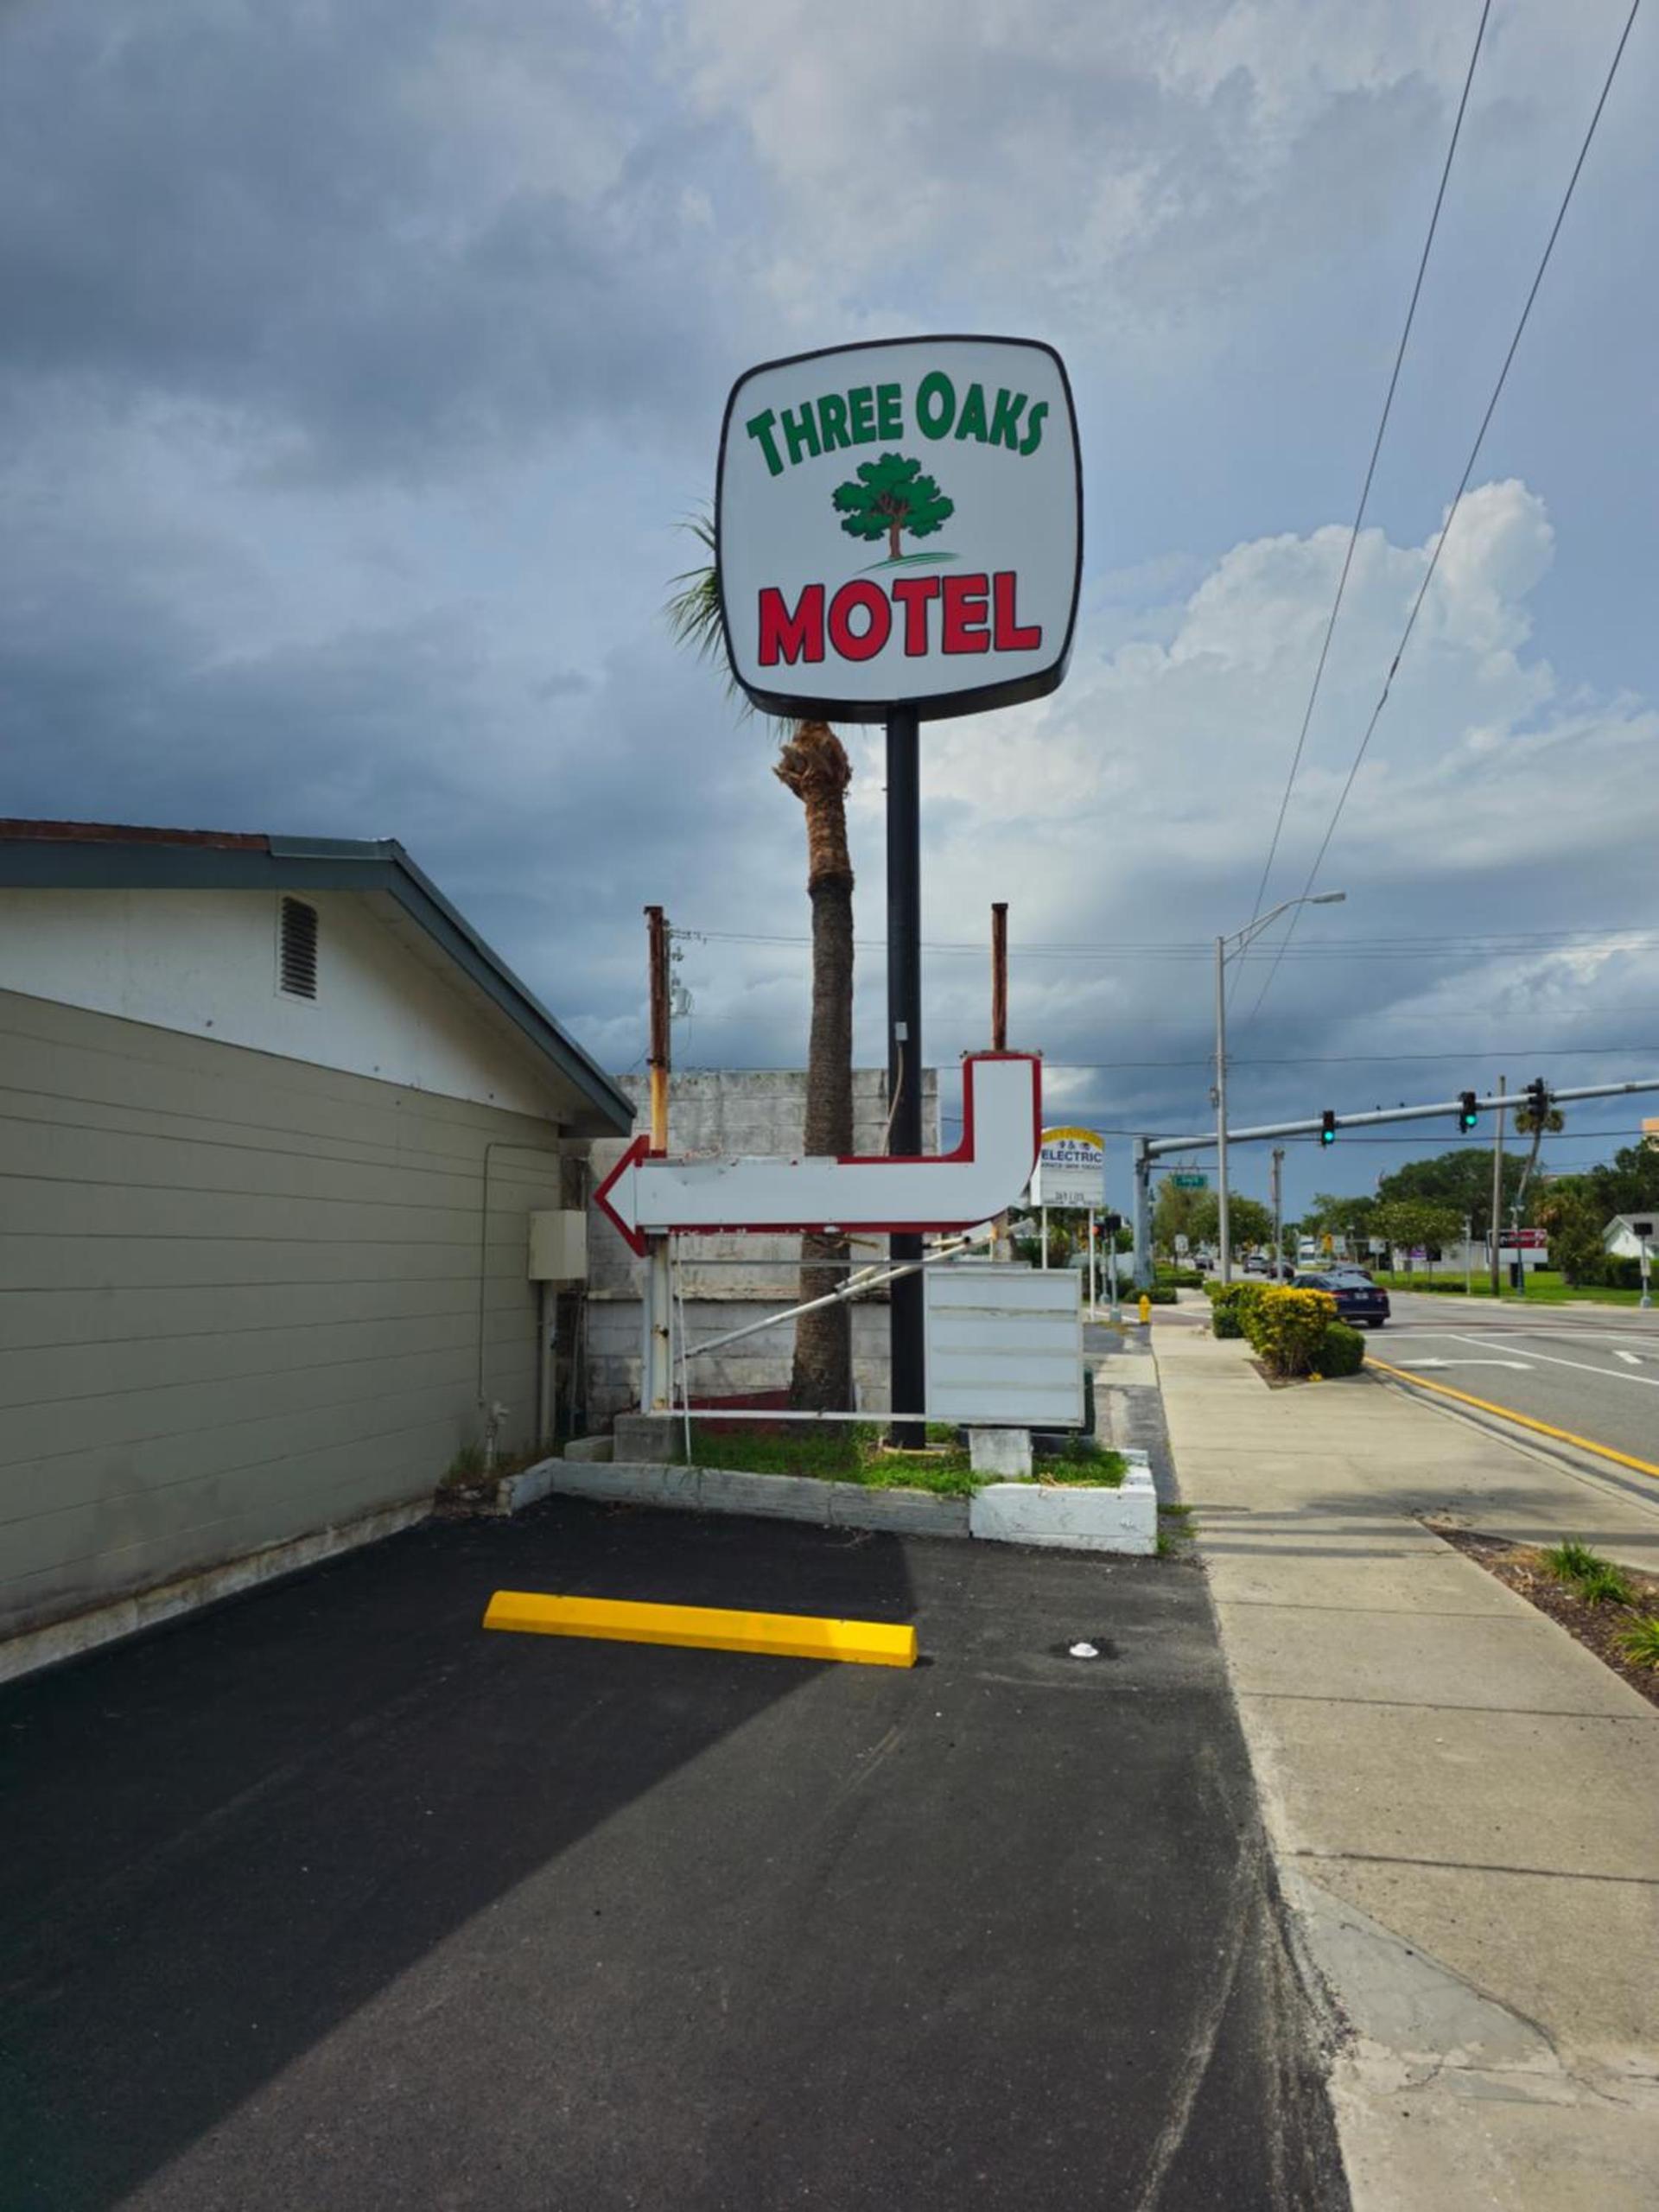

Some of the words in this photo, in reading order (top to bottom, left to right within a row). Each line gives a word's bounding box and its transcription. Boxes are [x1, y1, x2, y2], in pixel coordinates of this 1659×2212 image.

[746, 383, 904, 477] THREE
[915, 370, 1049, 457] OAKS
[758, 571, 1042, 666] MOTEL
[1041, 1149, 1103, 1163] ELECTRIC
